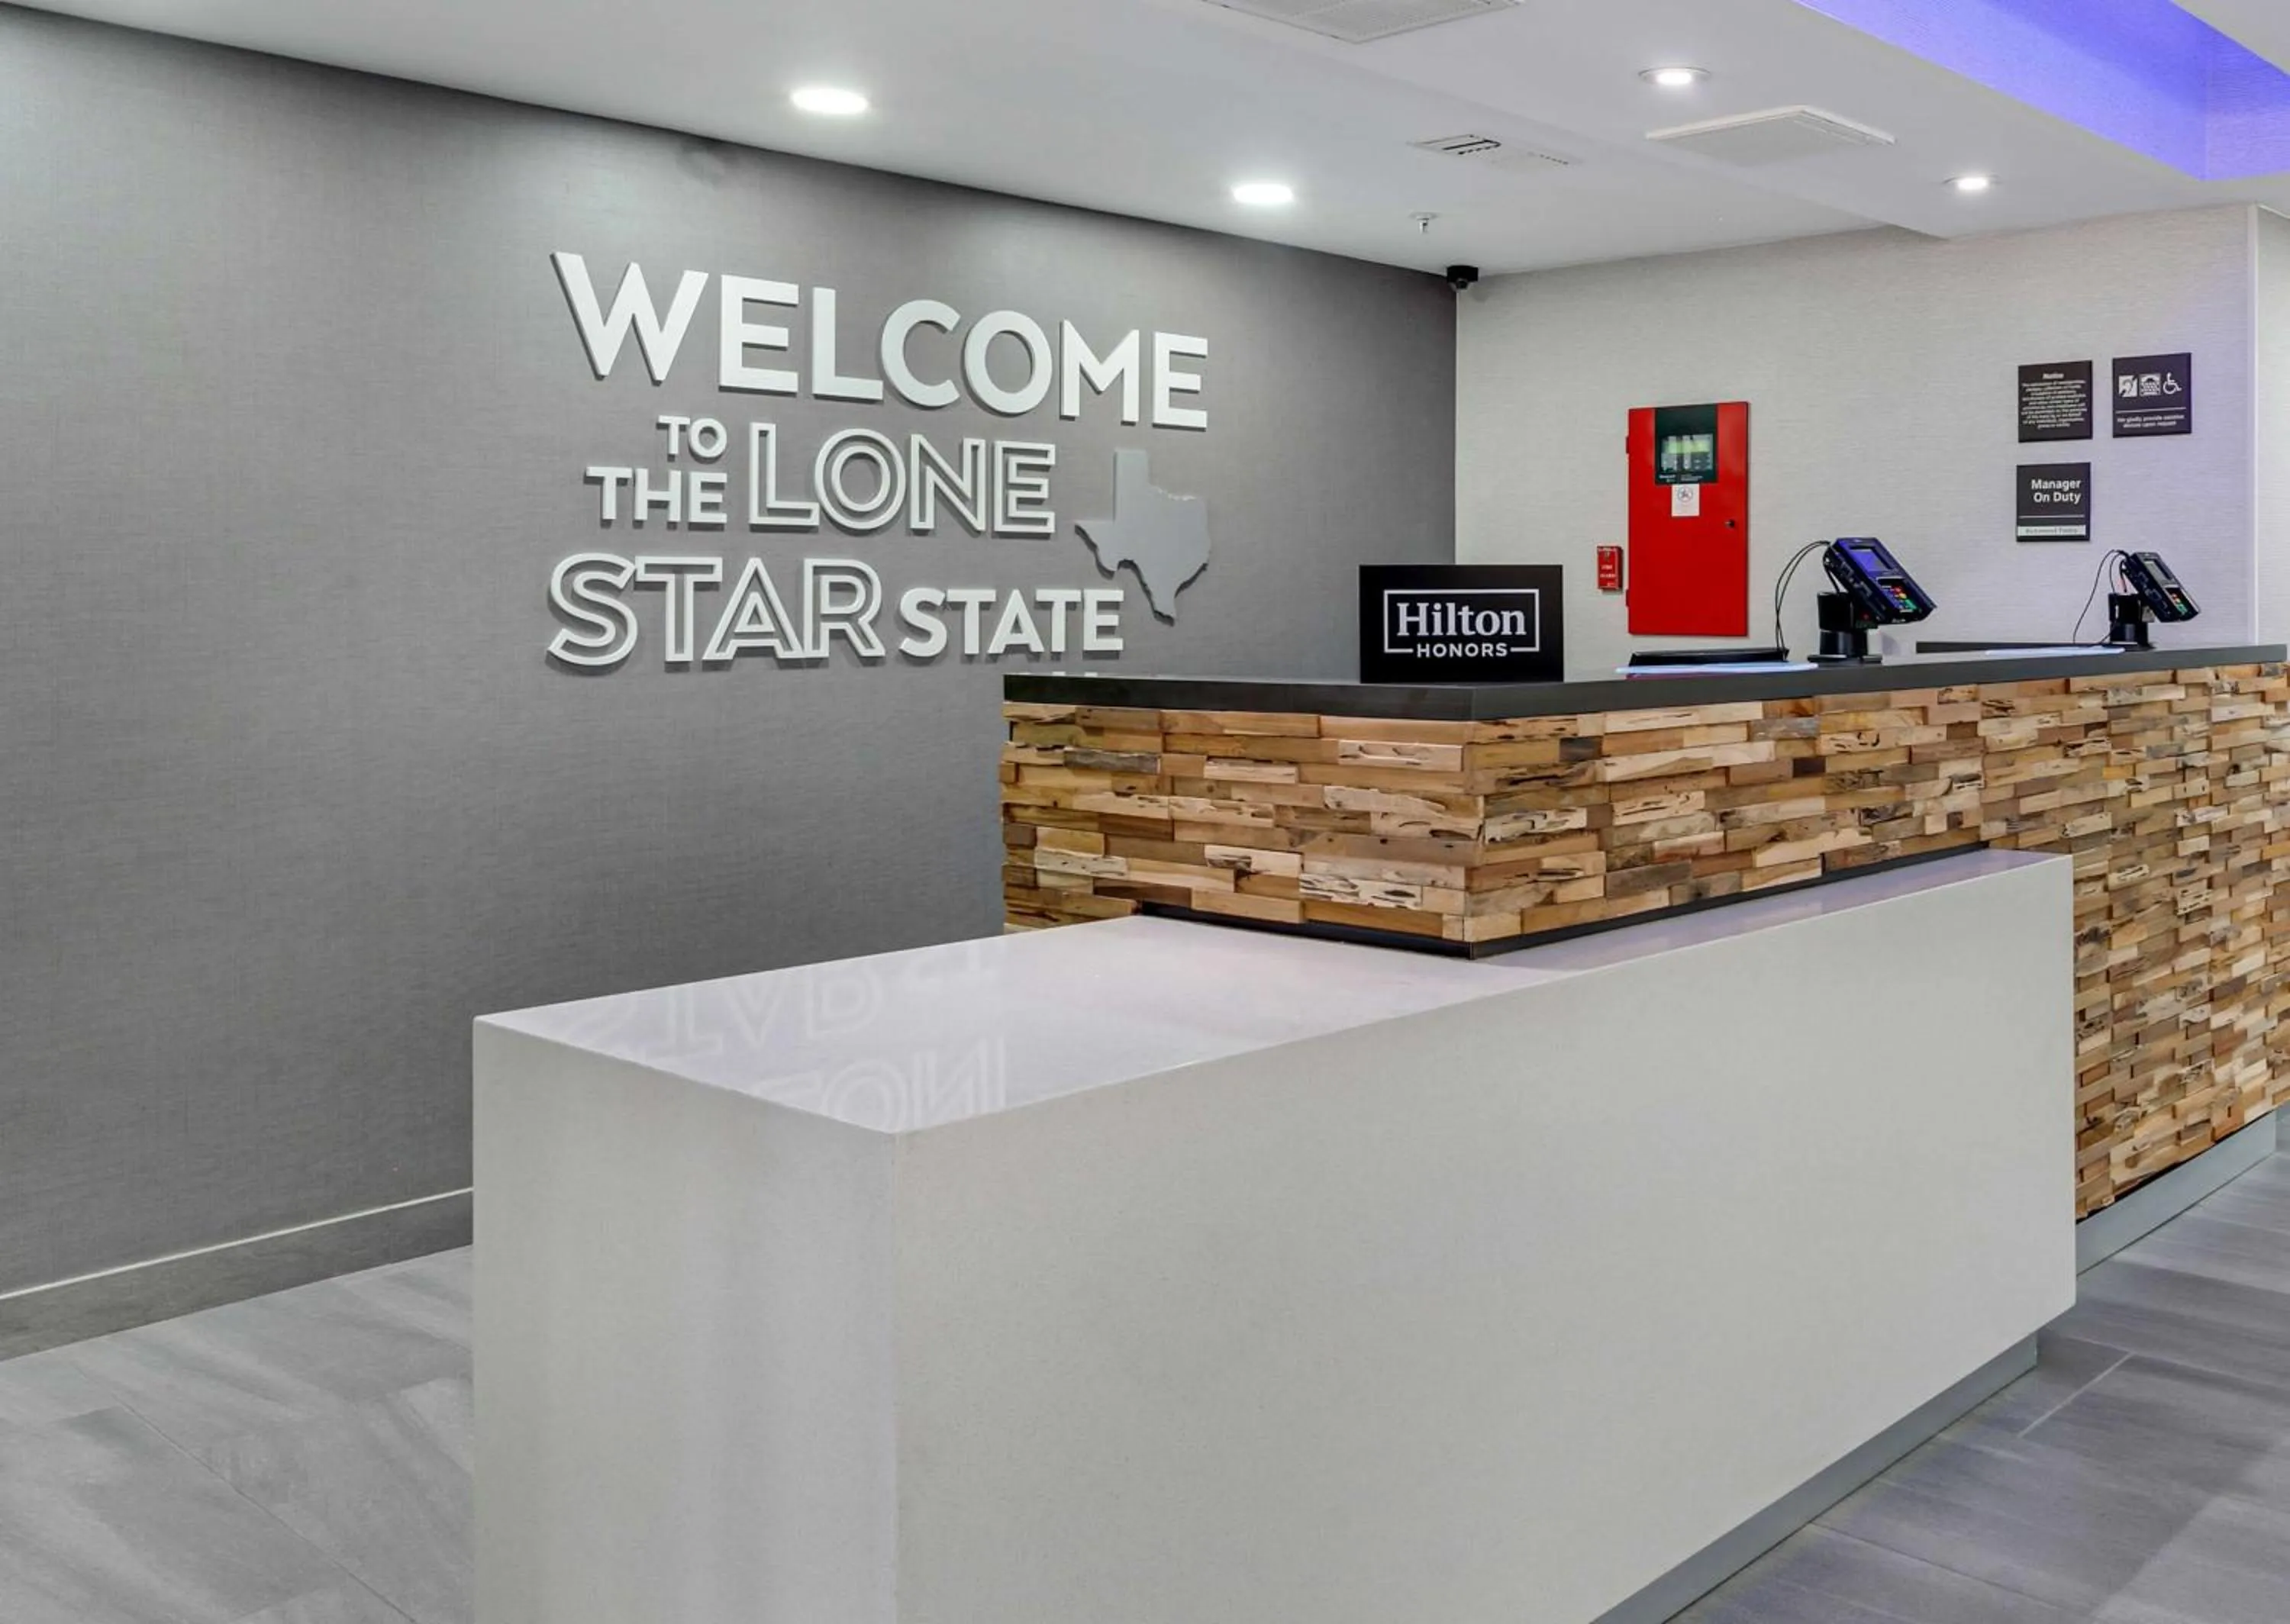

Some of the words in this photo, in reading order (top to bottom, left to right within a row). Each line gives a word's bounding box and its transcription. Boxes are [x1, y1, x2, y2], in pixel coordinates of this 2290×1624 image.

[550, 252, 1208, 429] WELCOME
[657, 415, 727, 459] TO
[585, 466, 727, 525] THE
[748, 422, 1056, 534] LONE
[2030, 478, 2082, 492] Manager
[2033, 492, 2050, 503] On
[2053, 491, 2082, 505] Duty
[546, 552, 886, 667] STAR
[899, 587, 1125, 658] STATE
[1396, 602, 1527, 636] Hilton
[1416, 643, 1508, 658] HONORS
